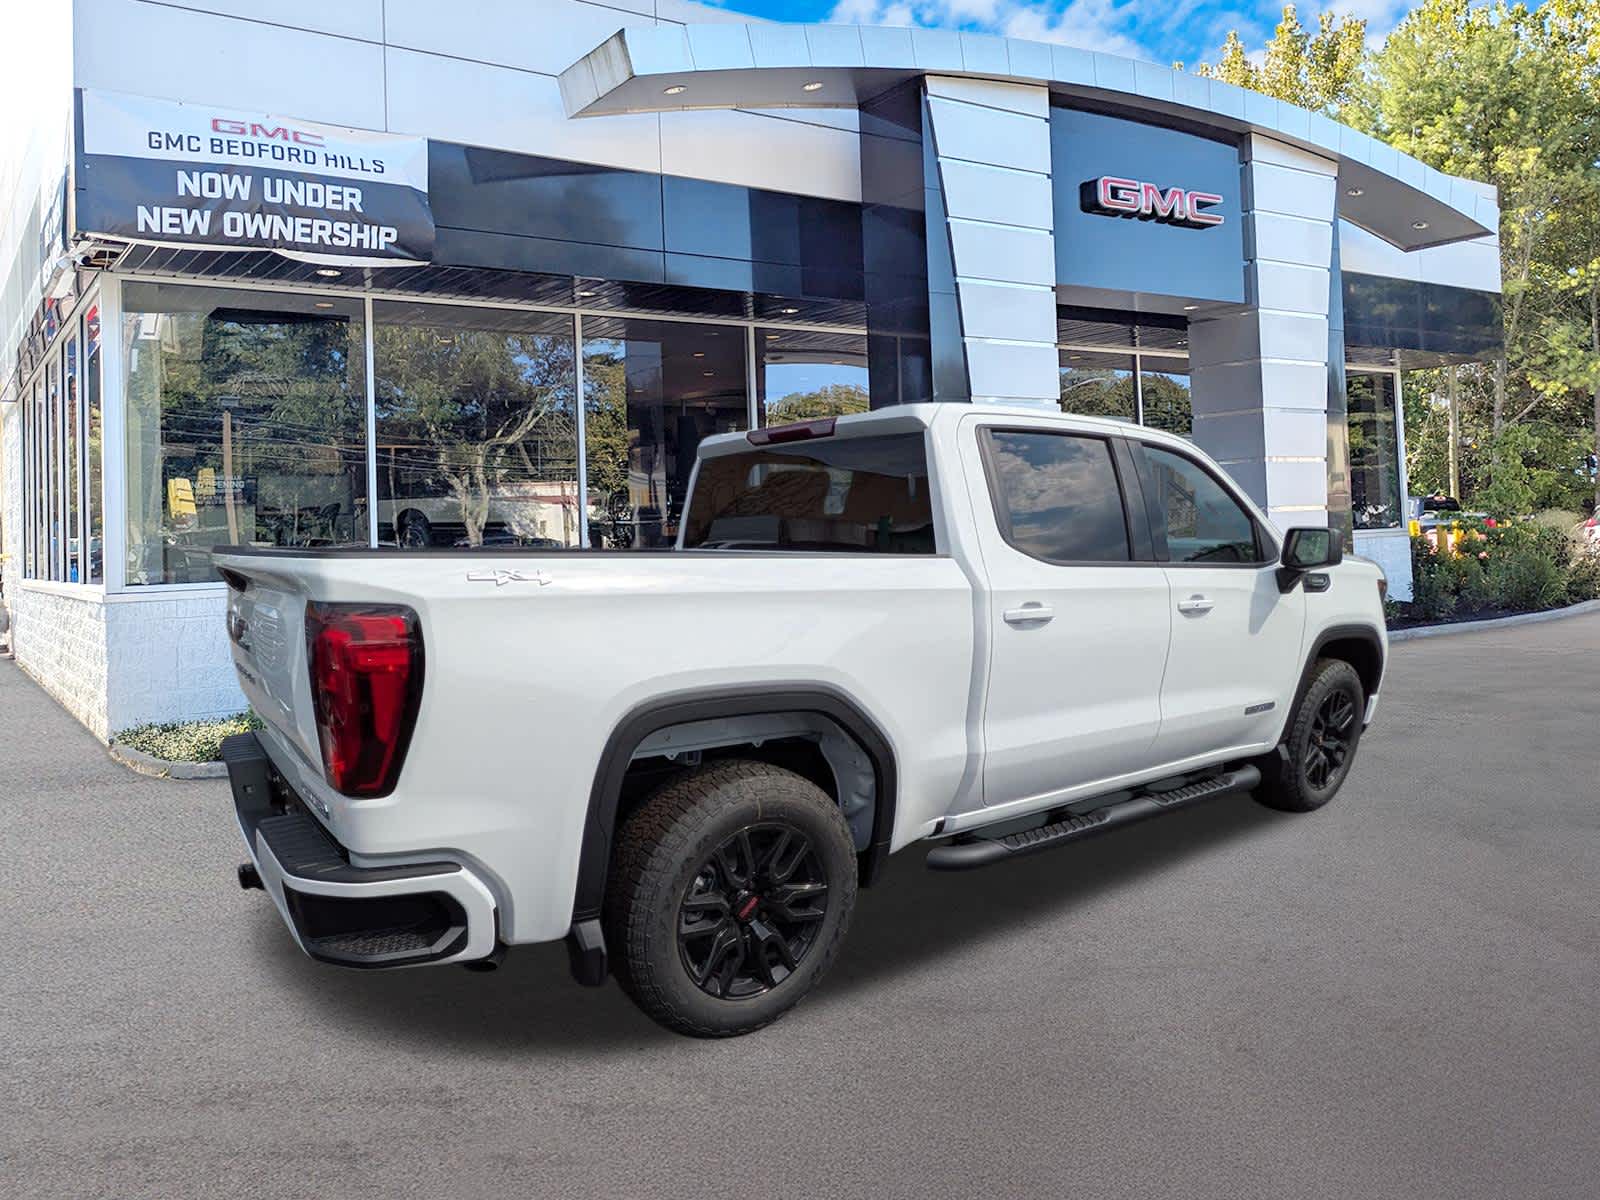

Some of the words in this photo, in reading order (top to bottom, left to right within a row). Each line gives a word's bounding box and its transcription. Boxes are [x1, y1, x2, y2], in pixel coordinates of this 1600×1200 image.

[148, 130, 201, 153] GMC
[210, 138, 317, 165] BEDFORD
[325, 152, 385, 174] HILLS
[212, 118, 325, 148] GMC
[176, 169, 252, 201] NOW
[264, 177, 363, 213] UNDER
[1097, 176, 1225, 224] GMC
[136, 205, 211, 236] NEW
[223, 211, 398, 250] OWNERSHIP
